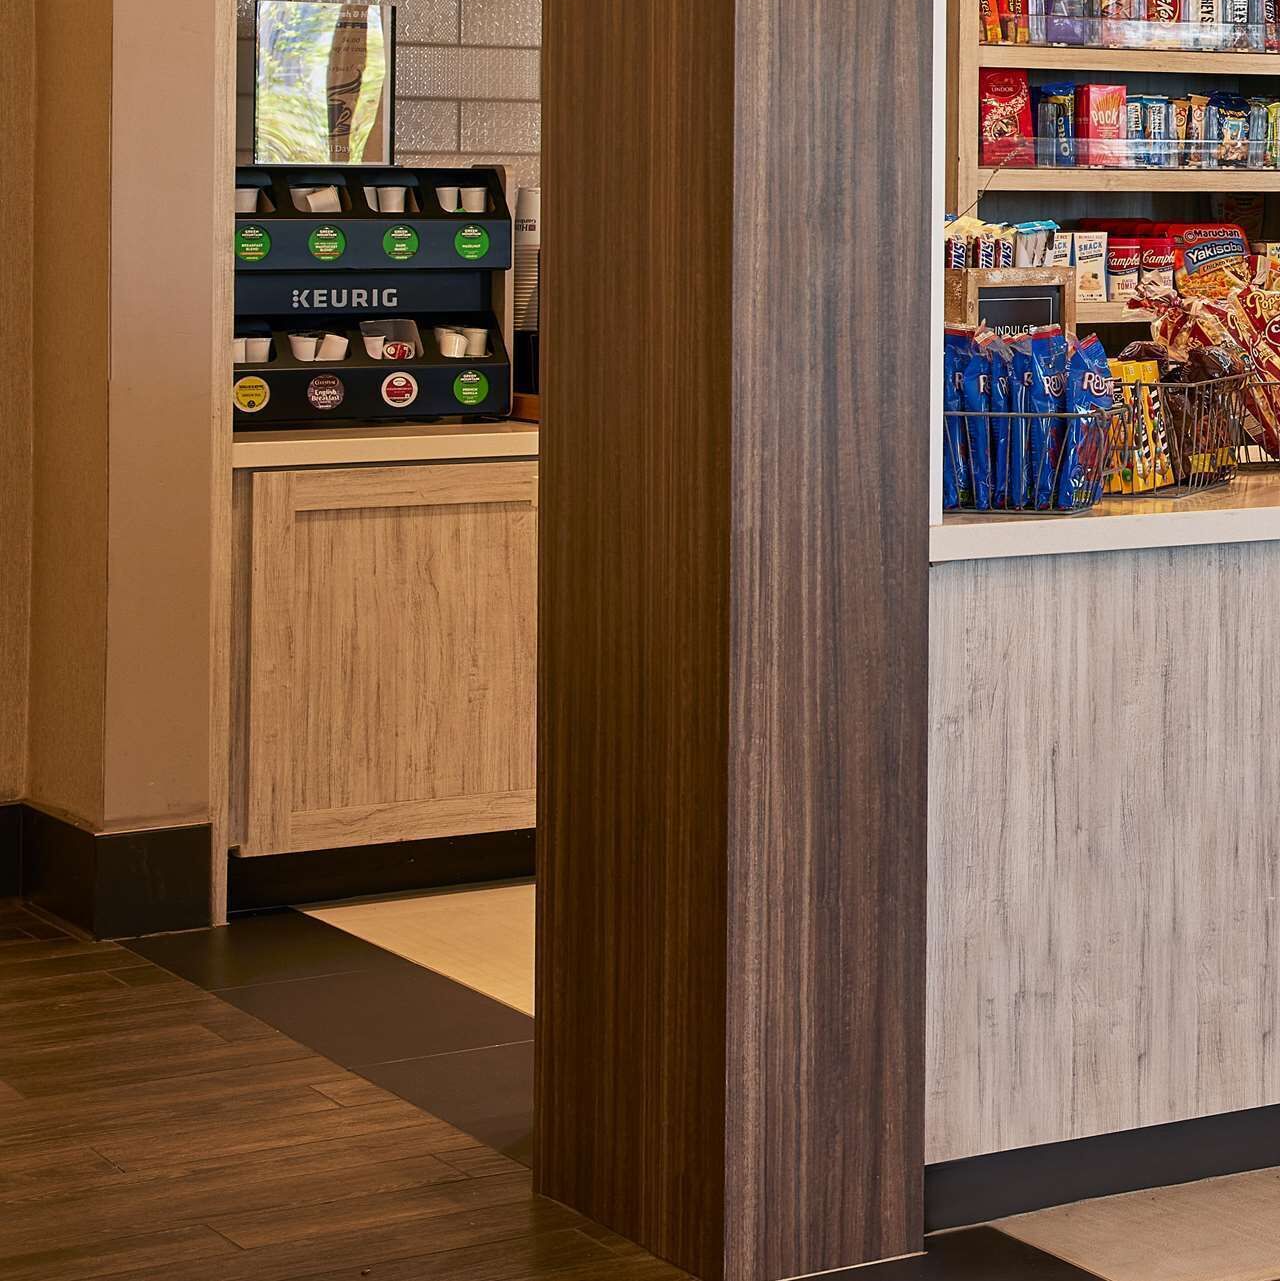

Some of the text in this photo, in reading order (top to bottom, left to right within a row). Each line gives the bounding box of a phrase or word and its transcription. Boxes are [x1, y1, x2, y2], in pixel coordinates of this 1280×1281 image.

[1057, 116, 1070, 157] OREO
[1195, 228, 1240, 239] Maruchan
[1078, 241, 1103, 251] SNACK
[1187, 242, 1244, 264] Yakisoba
[292, 288, 398, 308] KEURIG
